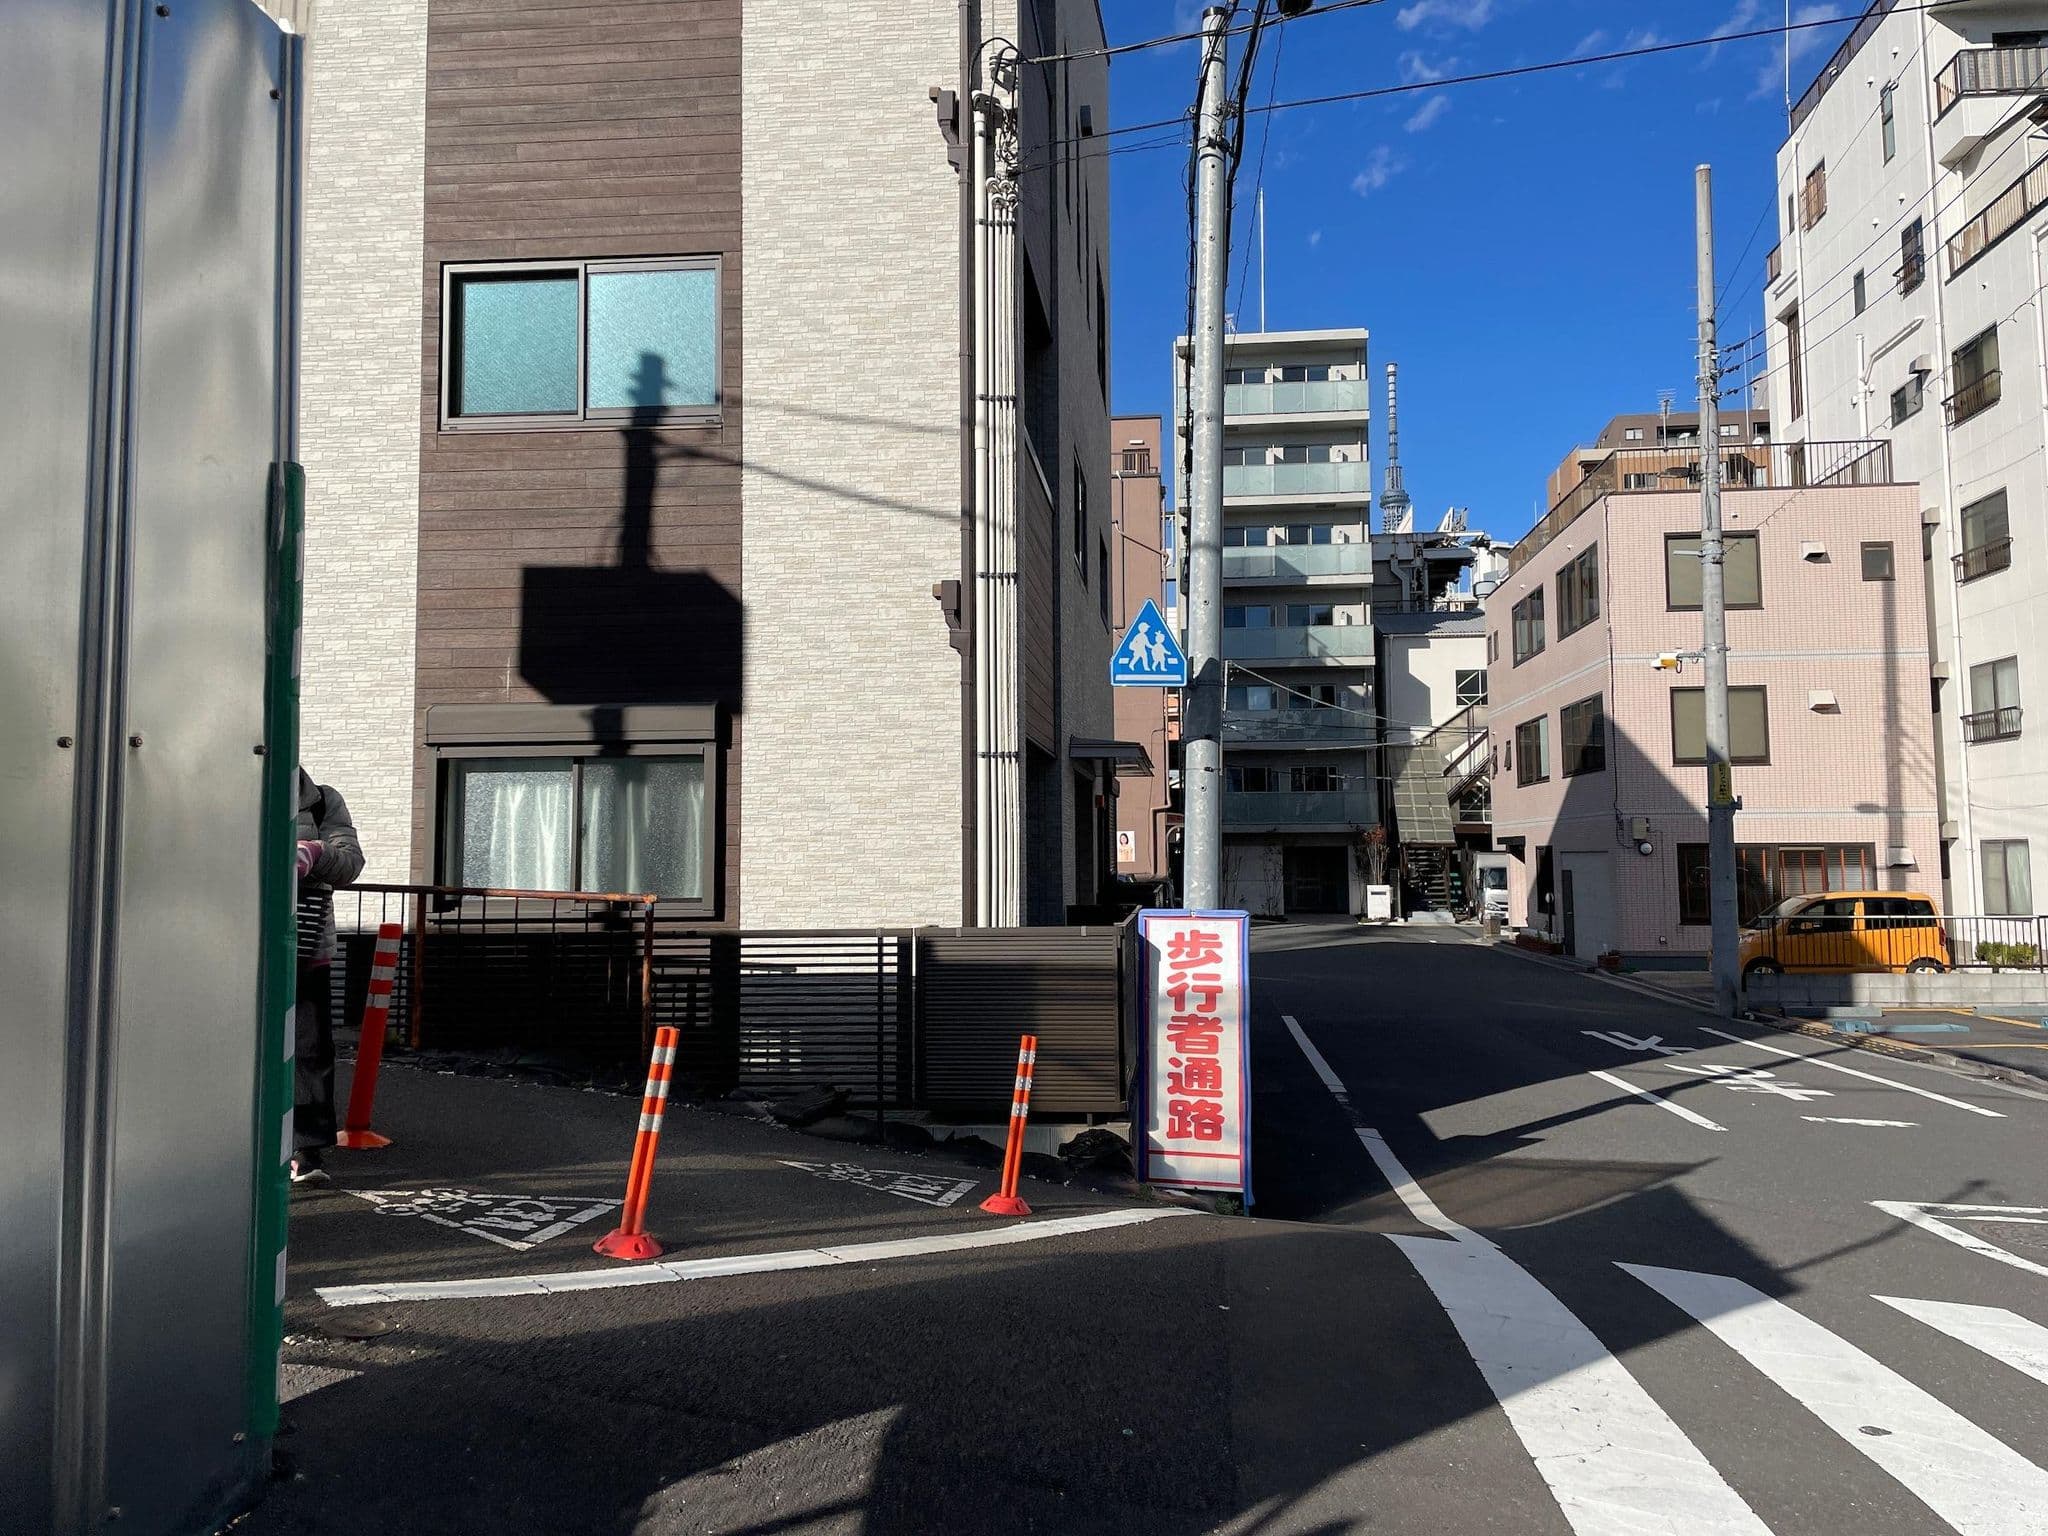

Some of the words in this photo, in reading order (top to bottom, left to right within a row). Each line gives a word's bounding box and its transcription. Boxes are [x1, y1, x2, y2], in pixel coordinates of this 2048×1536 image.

[1167, 930, 1223, 1141] 歩行者通路
